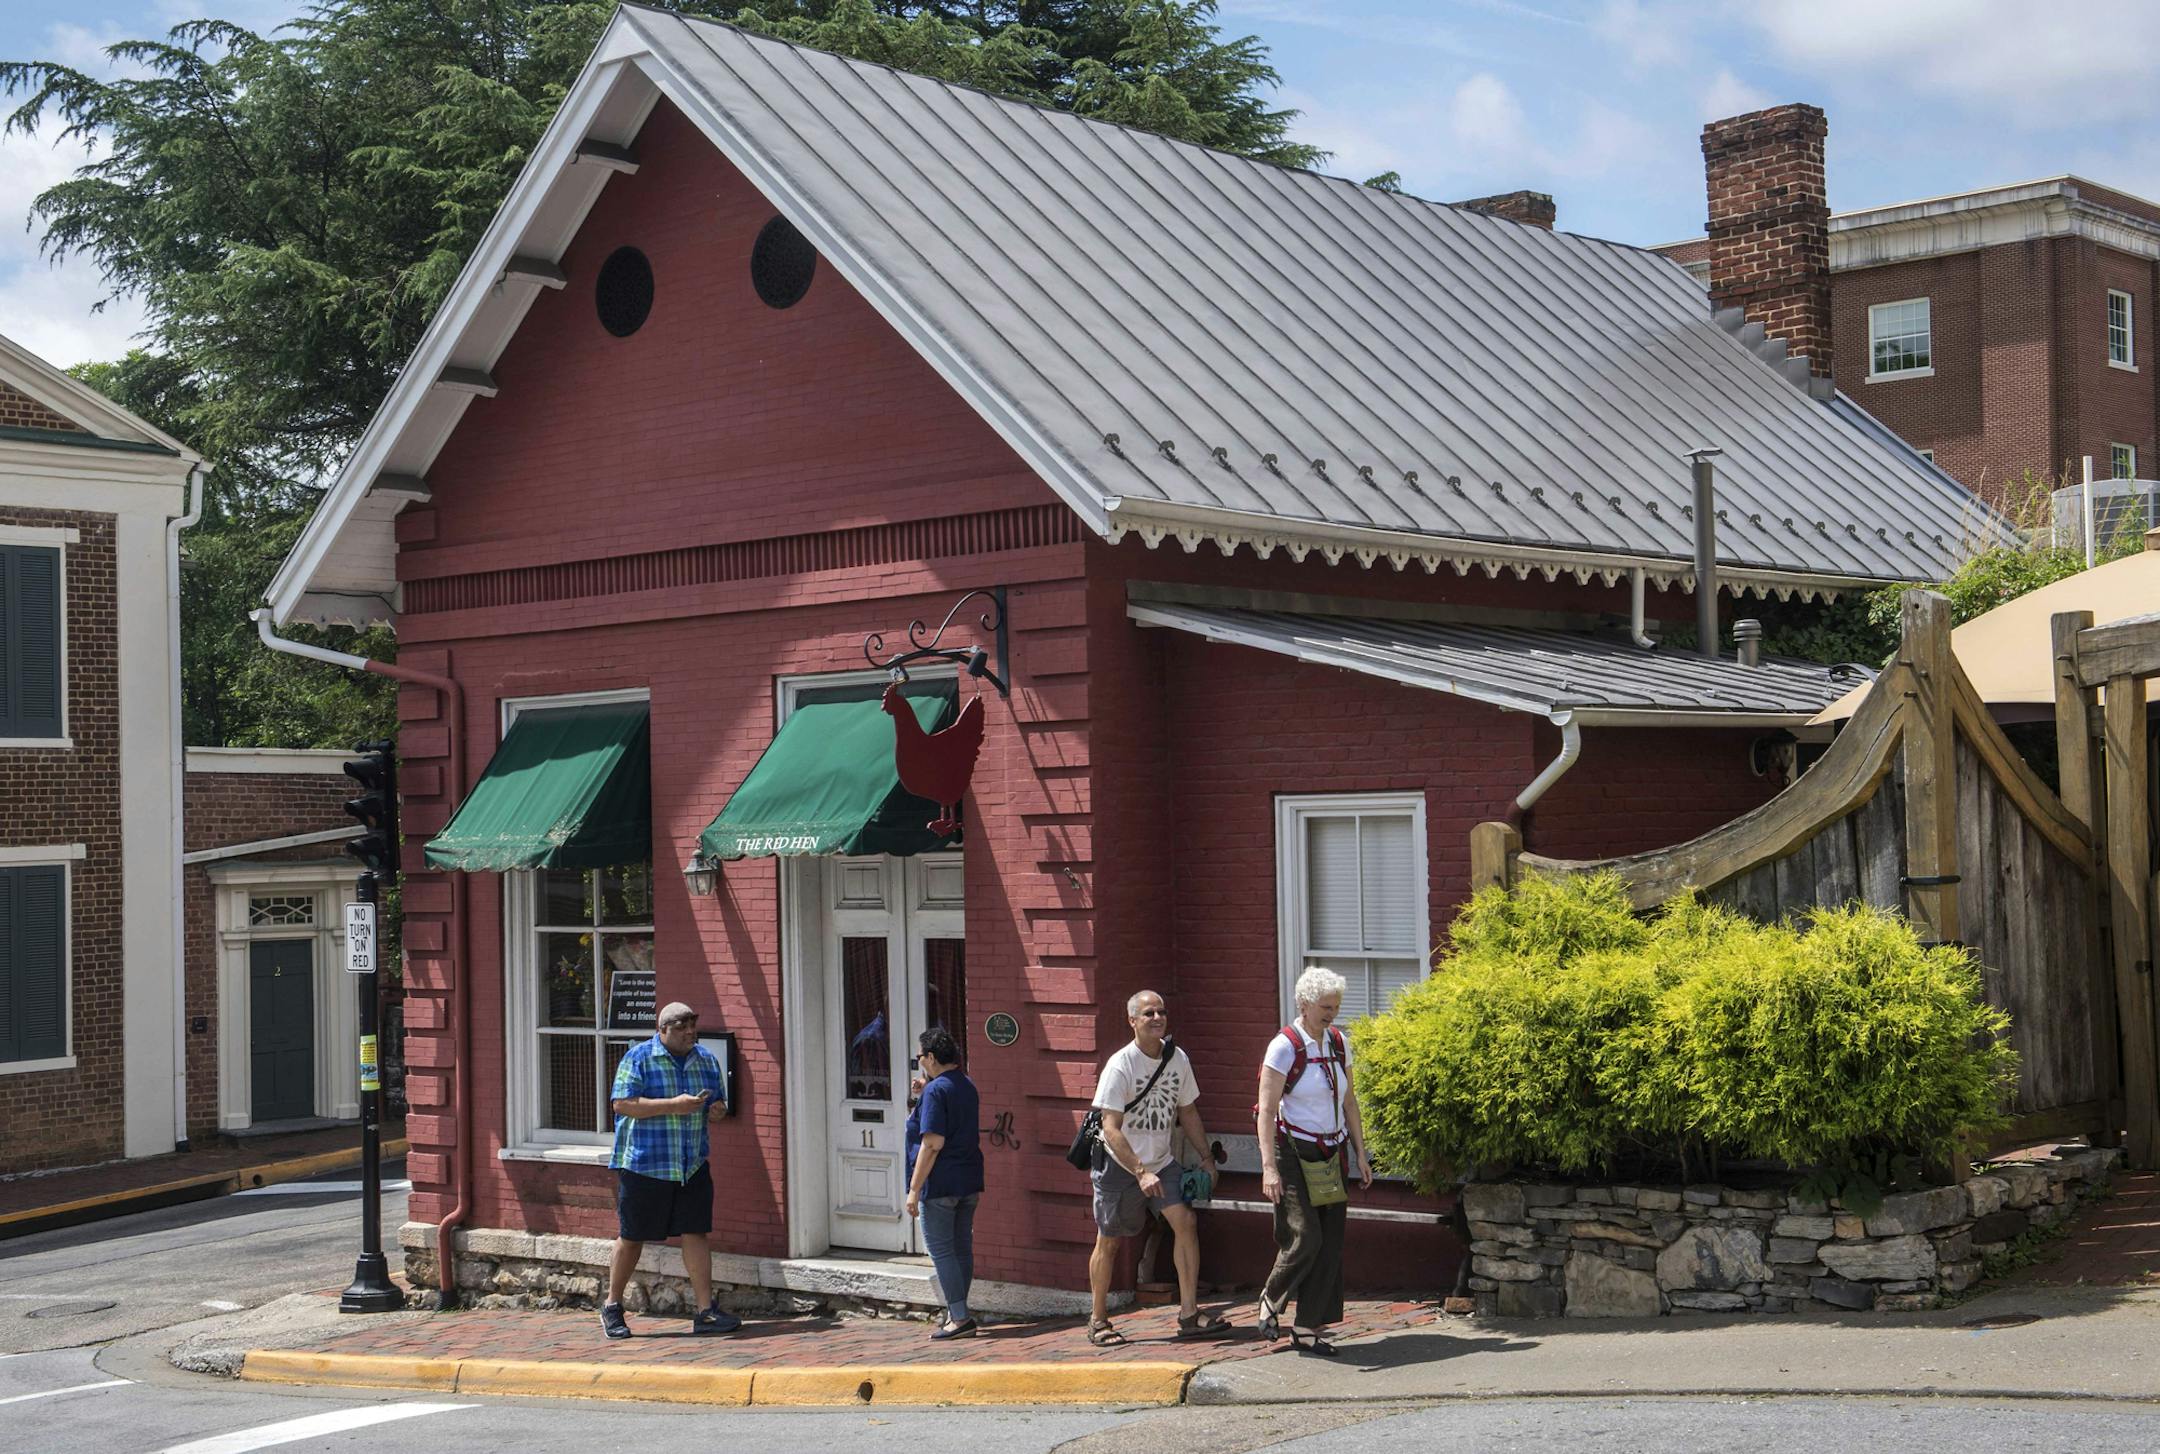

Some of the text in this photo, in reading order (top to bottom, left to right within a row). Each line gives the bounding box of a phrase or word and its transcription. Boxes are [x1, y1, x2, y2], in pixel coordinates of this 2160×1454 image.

[736, 836, 820, 851] THE RED HEN
[354, 908, 366, 921] NO
[350, 924, 371, 936] TURN
[354, 939, 366, 952] ON
[352, 954, 368, 967] RED
[274, 966, 281, 977] 2
[618, 1011, 631, 1020] into
[632, 1012, 637, 1020] a
[861, 1128, 875, 1149] 11
